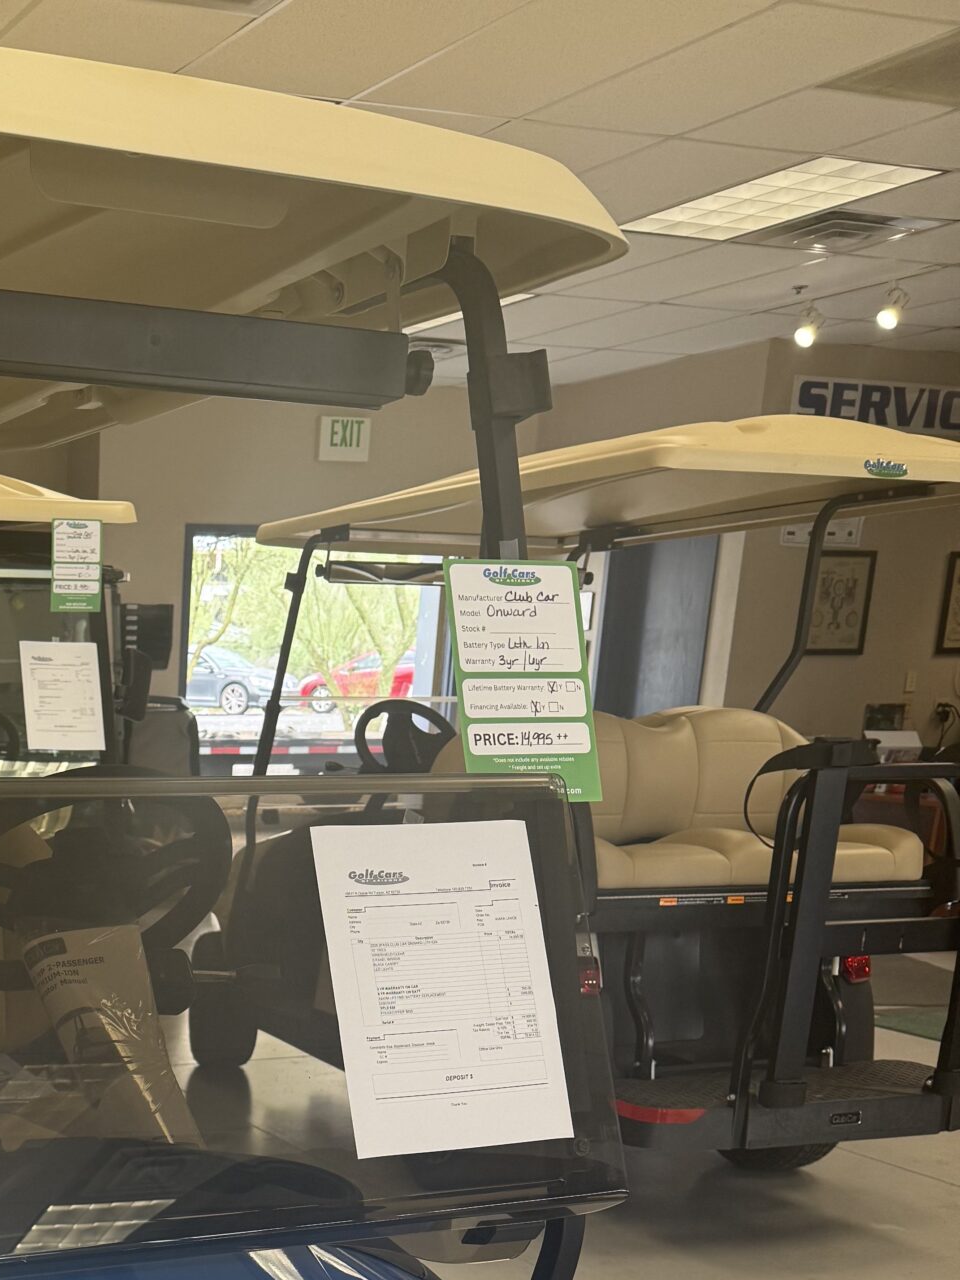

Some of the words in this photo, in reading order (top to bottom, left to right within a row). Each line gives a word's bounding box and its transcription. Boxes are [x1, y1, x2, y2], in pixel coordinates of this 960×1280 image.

[329, 419, 365, 448] EXIT
[483, 566, 508, 578] Golf
[511, 568, 536, 579] Cars
[458, 594, 503, 602] Manufacturer
[504, 590, 533, 603] Club
[536, 591, 559, 602] Car
[486, 604, 538, 618] Onward
[463, 641, 488, 650] Battery
[489, 641, 506, 650] Type
[465, 657, 496, 666] Warranty
[493, 684, 515, 693] Battery
[470, 703, 499, 711] Financing
[473, 732, 520, 746] PRICE:
[520, 730, 554, 747] 14,995
[348, 868, 374, 880] Golf
[377, 869, 404, 879] Cars
[445, 1074, 469, 1082] DEPOSIT
